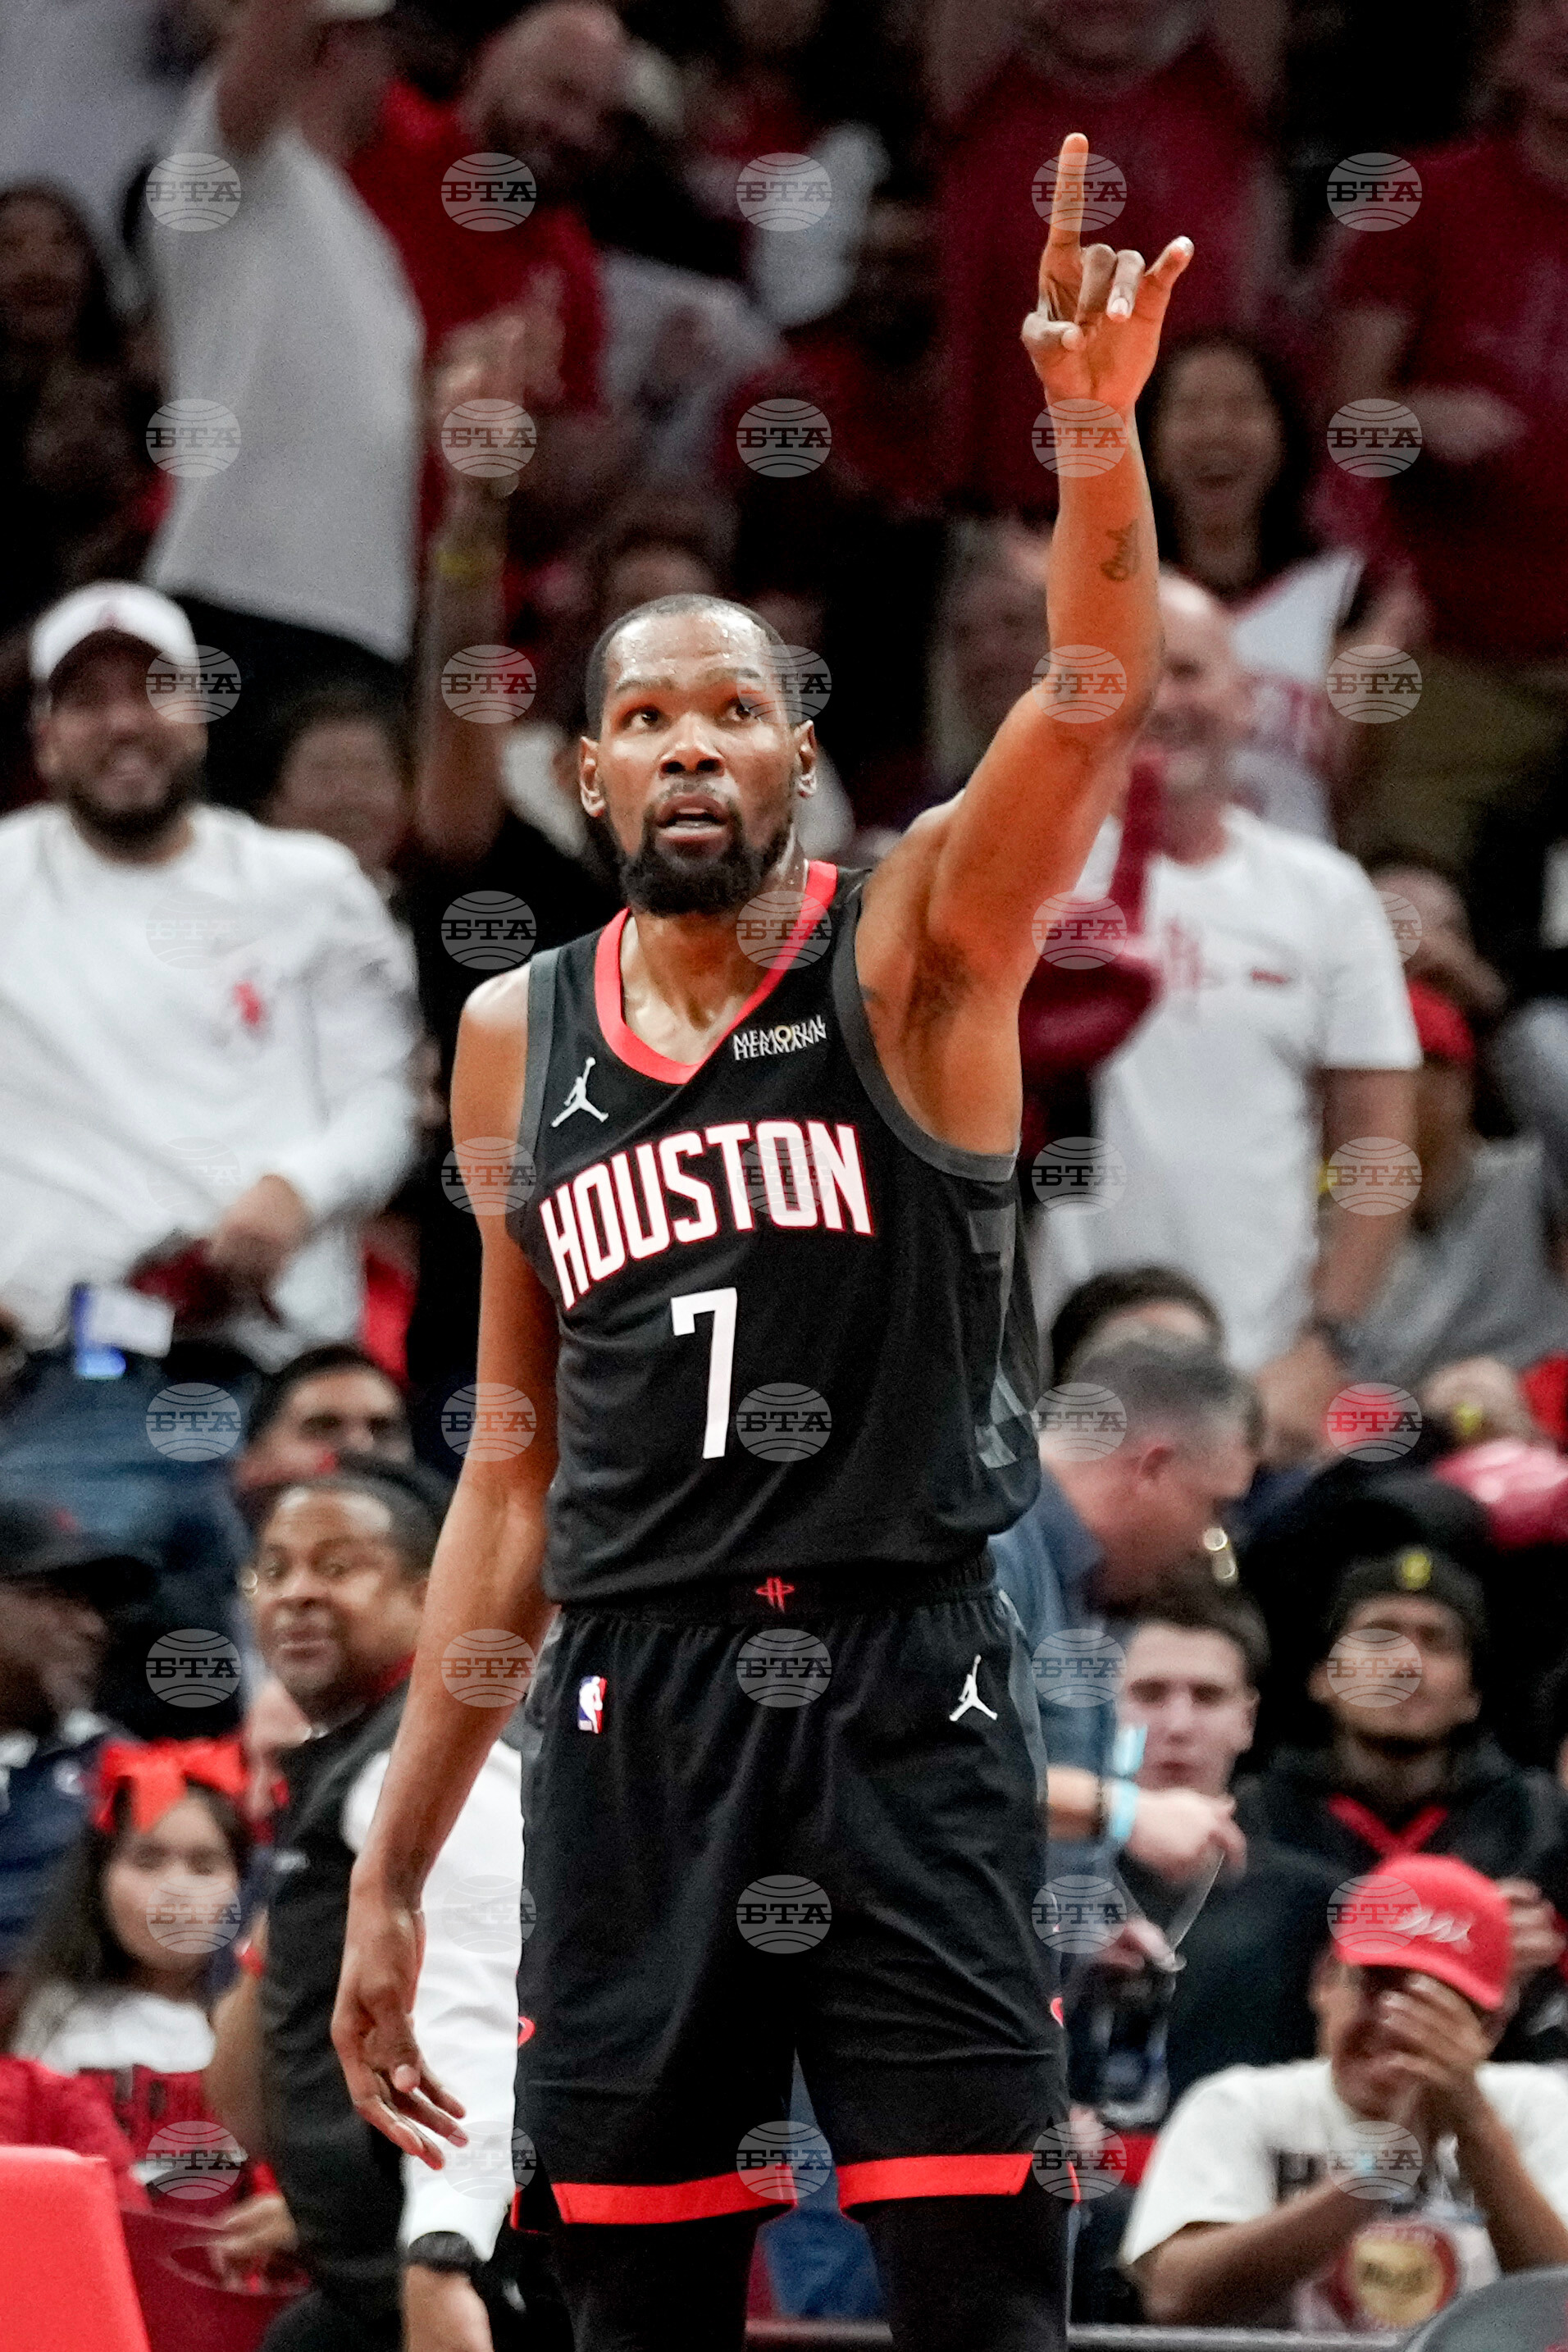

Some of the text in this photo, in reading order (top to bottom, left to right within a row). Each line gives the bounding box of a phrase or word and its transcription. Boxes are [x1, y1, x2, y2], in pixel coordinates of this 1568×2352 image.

[732, 1014, 827, 1047] MEMORIAL
[734, 1022, 827, 1061] HERMANN
[539, 1119, 874, 1311] HOUSTON
[670, 1286, 738, 1460] 7
